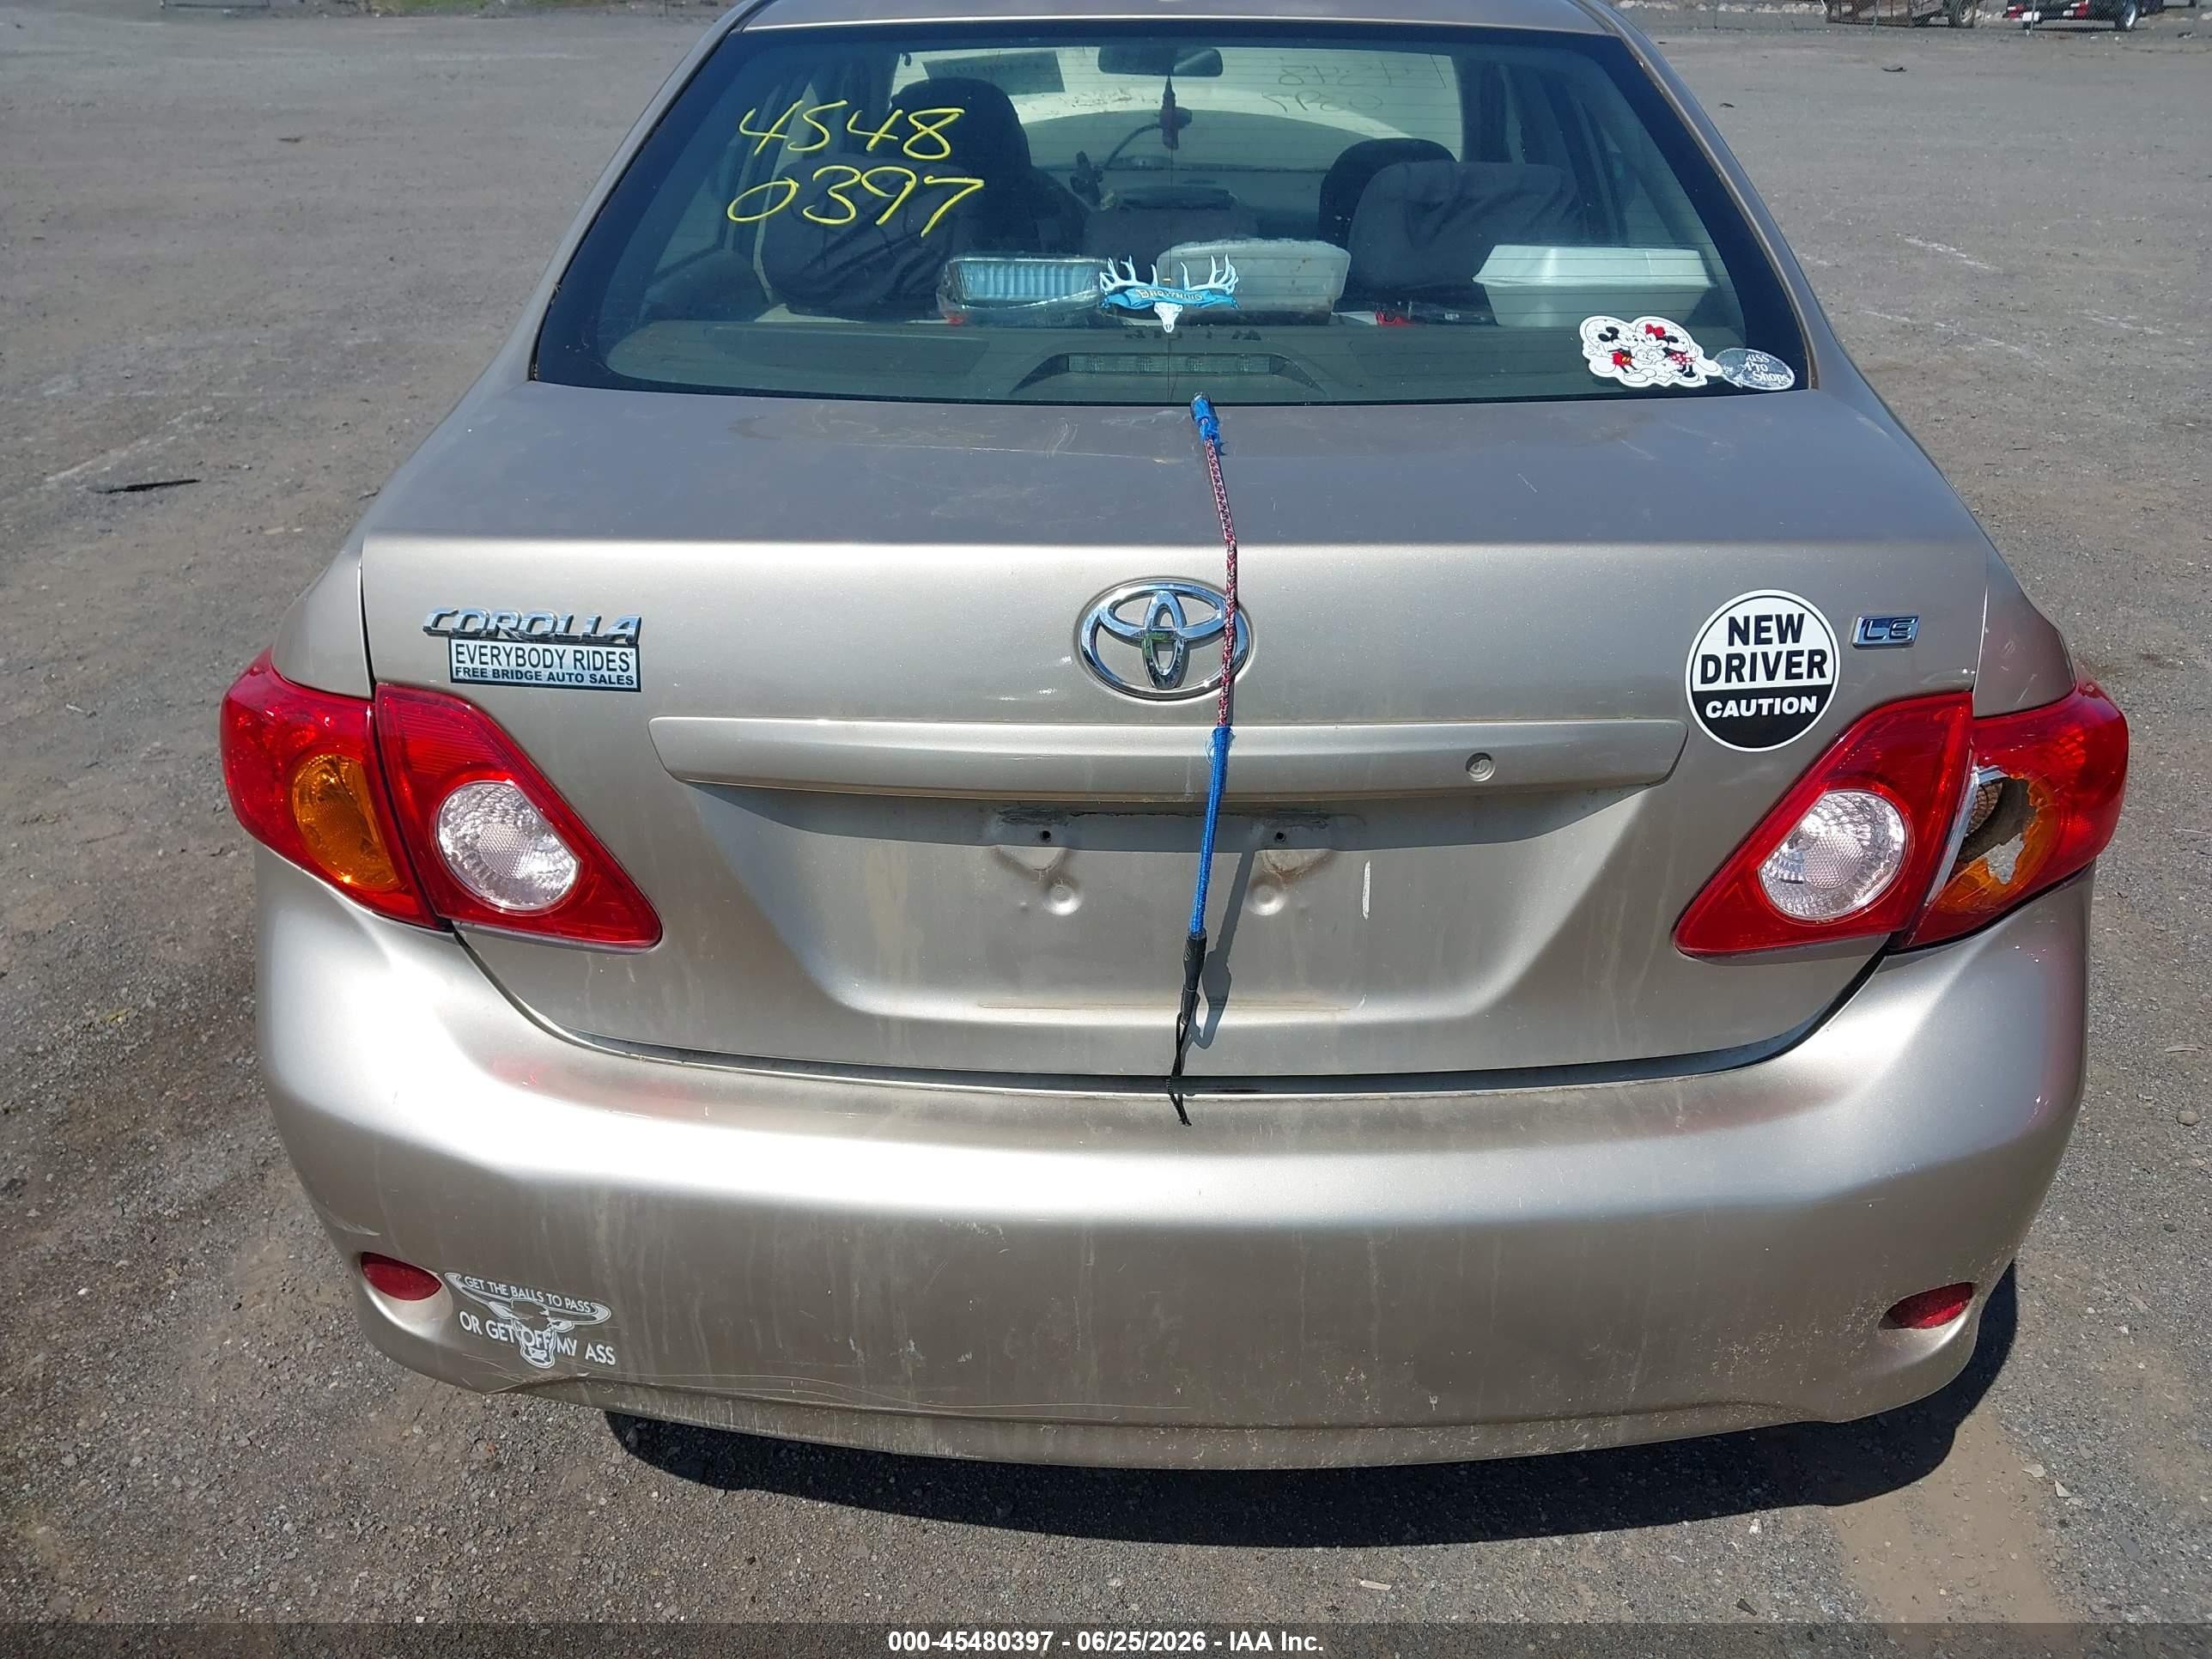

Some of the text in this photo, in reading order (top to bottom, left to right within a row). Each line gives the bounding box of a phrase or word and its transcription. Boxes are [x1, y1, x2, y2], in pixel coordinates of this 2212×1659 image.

[738, 99, 965, 160] 4548
[726, 165, 985, 239] 0397
[1135, 288, 1204, 302] BROWNING
[1752, 370, 1790, 385] Shops
[422, 607, 642, 645] COROLLA
[1728, 613, 1805, 647] NEW
[1863, 617, 1917, 641] LE
[455, 643, 567, 670] EVERYBODY
[1700, 648, 1828, 685] DRIVER
[455, 666, 635, 685] FREE BRIDGE AUTO SALES
[1705, 696, 1818, 719] CAUTION
[464, 1275, 591, 1313] GET THE BALLS TO PASS
[459, 1310, 617, 1366] OR GET OFF MY ASS
